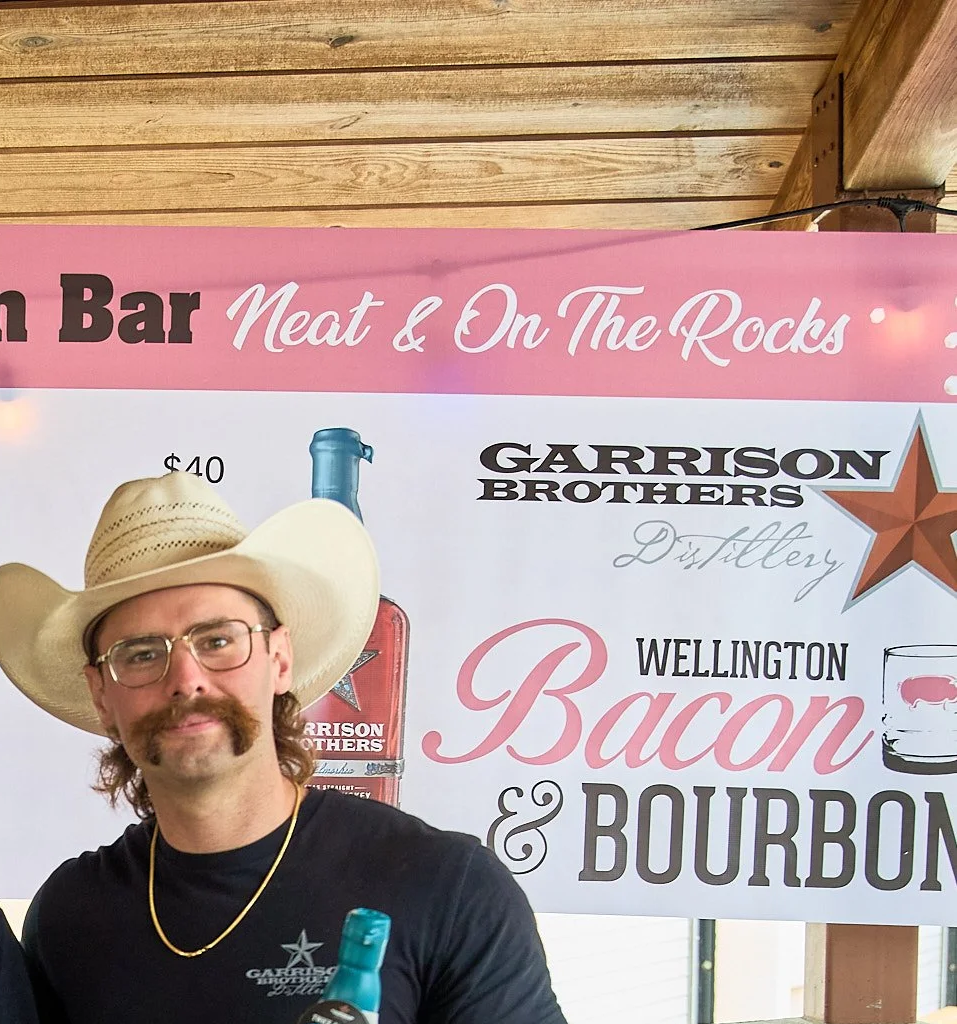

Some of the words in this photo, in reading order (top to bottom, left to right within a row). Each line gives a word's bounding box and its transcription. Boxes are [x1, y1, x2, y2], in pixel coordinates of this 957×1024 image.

[59, 274, 200, 345] Bar
[227, 282, 384, 353] Neat
[393, 296, 442, 353] &
[454, 284, 549, 353] On
[558, 286, 661, 357] The
[669, 290, 851, 366] Rocks
[163, 453, 225, 484] $40
[476, 478, 805, 508] BROTHERS
[479, 442, 892, 481] GARRISON
[613, 520, 846, 602] Distillery
[636, 637, 849, 681] WELLINGTON
[422, 618, 875, 775] Bacon
[488, 780, 564, 875] &
